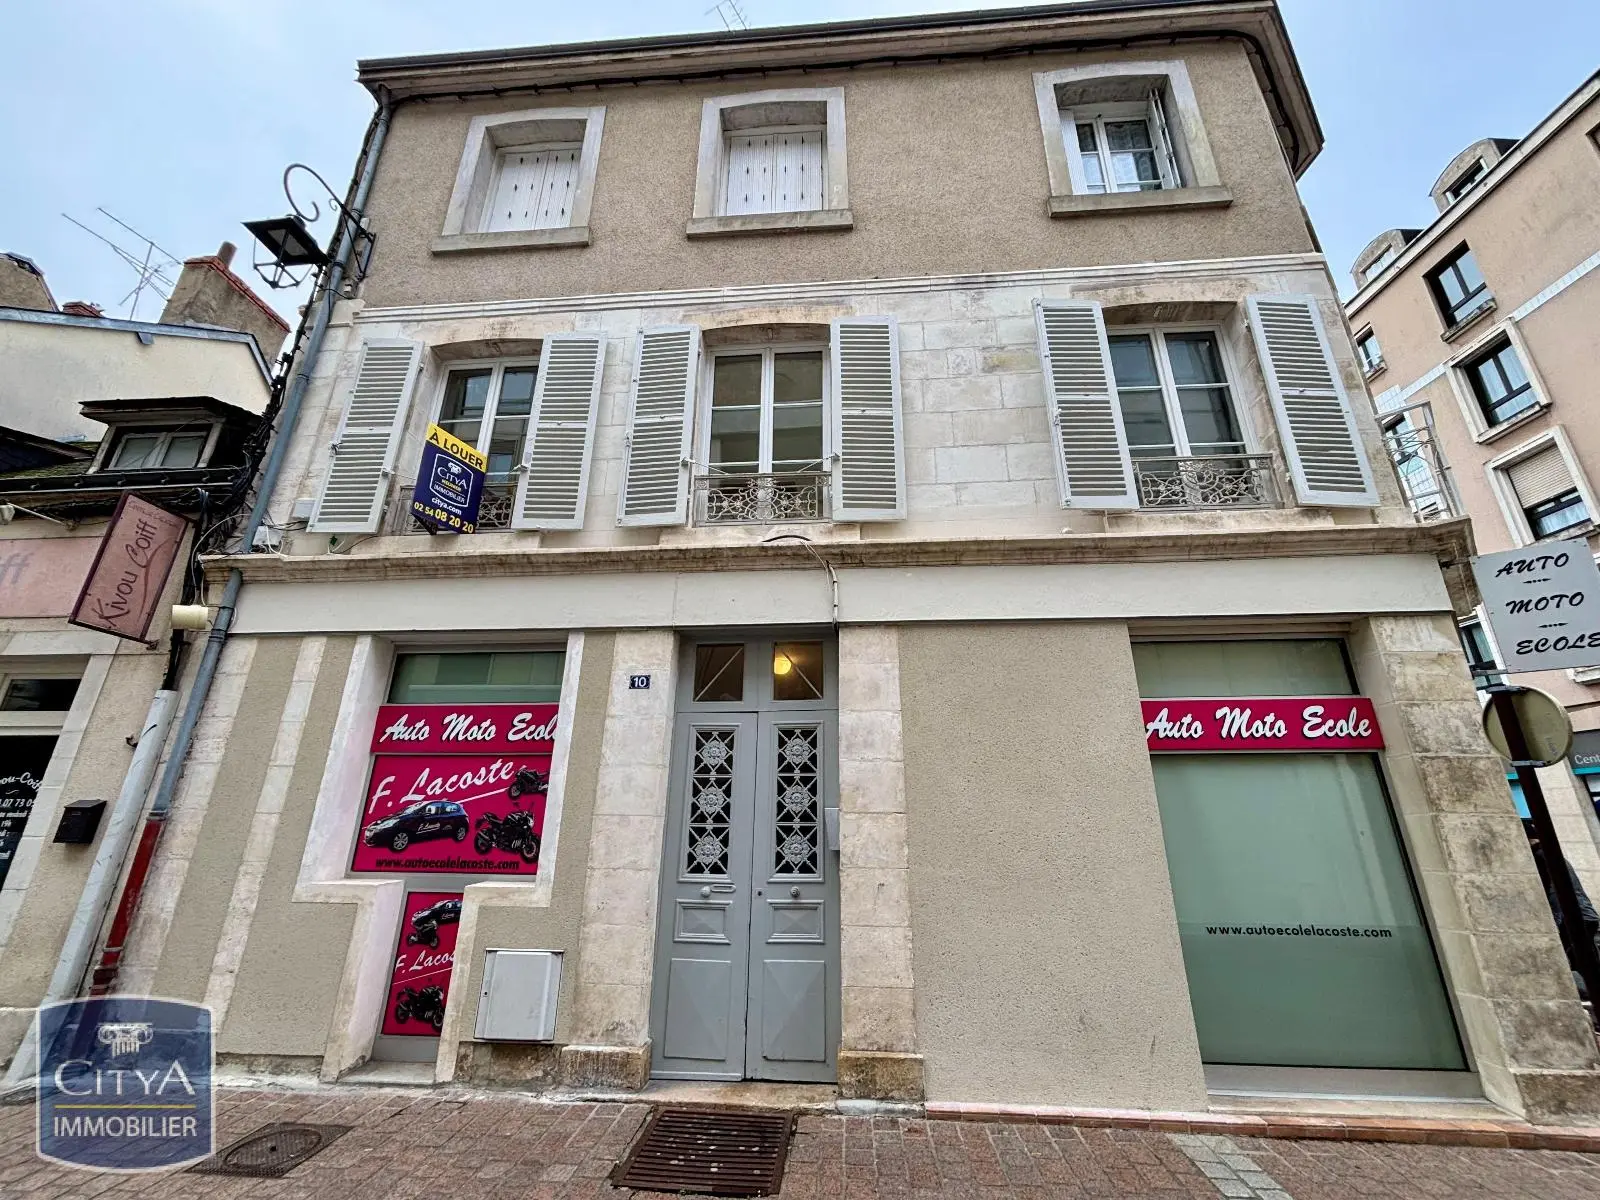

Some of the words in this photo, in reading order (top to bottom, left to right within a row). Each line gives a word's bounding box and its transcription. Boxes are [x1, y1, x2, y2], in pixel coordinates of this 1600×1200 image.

[429, 429, 440, 445] À
[443, 438, 484, 470] LOUER
[437, 466, 468, 490] CITYA
[414, 501, 424, 512] 02
[425, 507, 434, 516] 54
[435, 508, 447, 522] 08
[449, 515, 460, 528] 20
[462, 520, 474, 533] 20
[431, 496, 462, 516] citya.com
[91, 571, 138, 627] Kivou
[125, 518, 158, 568] Coiff
[1495, 552, 1569, 577] AUTO
[1506, 591, 1585, 614] MOTO
[1516, 631, 1600, 654] ECOLE
[634, 676, 647, 687] 10
[380, 713, 430, 742] Auto
[442, 712, 496, 741] Moto
[1146, 707, 1204, 740] Auto
[1215, 706, 1287, 739] Moto
[1302, 705, 1372, 738] Ecole
[368, 776, 396, 814] F.
[400, 758, 514, 804] Lacoste
[375, 856, 520, 870] www.autoecolelacoste.com
[1206, 925, 1392, 938] www.autoecolelacoste.com
